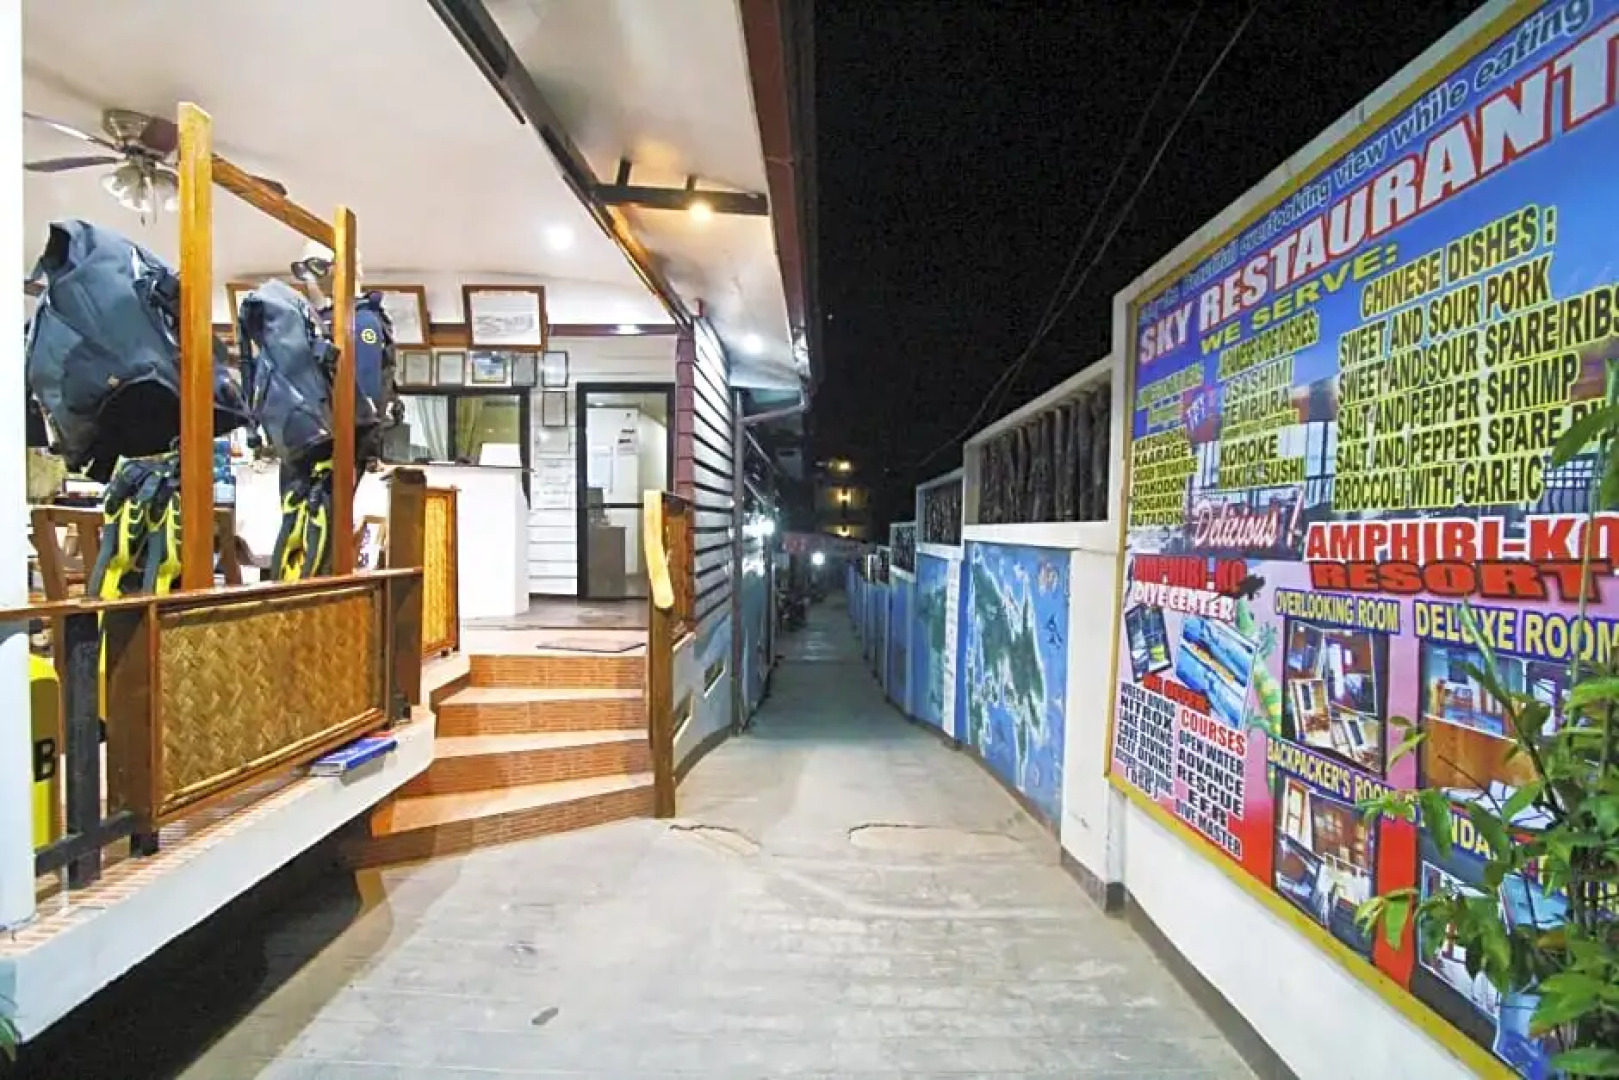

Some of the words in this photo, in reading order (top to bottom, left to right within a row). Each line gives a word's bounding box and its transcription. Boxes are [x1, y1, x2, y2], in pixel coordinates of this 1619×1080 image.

[1335, 137, 1389, 189] view
[1391, 79, 1468, 150] while
[1474, 0, 1592, 92] eating
[1140, 301, 1193, 365] SKY
[1199, 14, 1619, 333] RESTAURANT
[1362, 249, 1442, 319] CHINESE
[1448, 206, 1538, 284] DISHES
[1202, 322, 1240, 354] WE
[1254, 243, 1398, 330] SERVE:
[1340, 322, 1387, 369] SWEET
[1390, 306, 1424, 348] AND
[1428, 284, 1481, 339] SOUR
[1486, 256, 1550, 320] PORK
[1338, 361, 1384, 405] SWEET
[1388, 347, 1424, 392] AND
[1426, 331, 1479, 381] SOUR
[1484, 305, 1560, 367] SPARE
[1223, 386, 1289, 427] TEMPURA
[1337, 404, 1370, 441] SALT
[1374, 399, 1405, 437] AND
[1409, 378, 1480, 428] PEPPER
[1486, 353, 1578, 413] SHRIMP
[1220, 433, 1278, 466] KOROKE
[1335, 443, 1370, 473] SALT
[1373, 438, 1405, 469] AND
[1409, 423, 1481, 464] PEPPER
[1488, 408, 1562, 455] SPARE
[1264, 457, 1305, 485] SUSHI
[1335, 472, 1406, 510] BROCCOLI
[1411, 464, 1456, 506] WITH
[1461, 456, 1543, 505] GARLIC
[1193, 499, 1282, 548] Delicious
[1311, 560, 1613, 603] RESORT
[1275, 590, 1355, 626] OVERLOOKING
[1358, 598, 1400, 633] ROOM
[1415, 602, 1517, 651] DELUXE
[1120, 695, 1173, 732] NITROX
[1181, 709, 1245, 757] COURSES
[1138, 746, 1172, 779] DIVING
[1178, 748, 1243, 798] ADVANCE
[1205, 743, 1244, 778] WATER
[1177, 765, 1243, 817] RESCUE
[1198, 814, 1241, 857] MASTER
